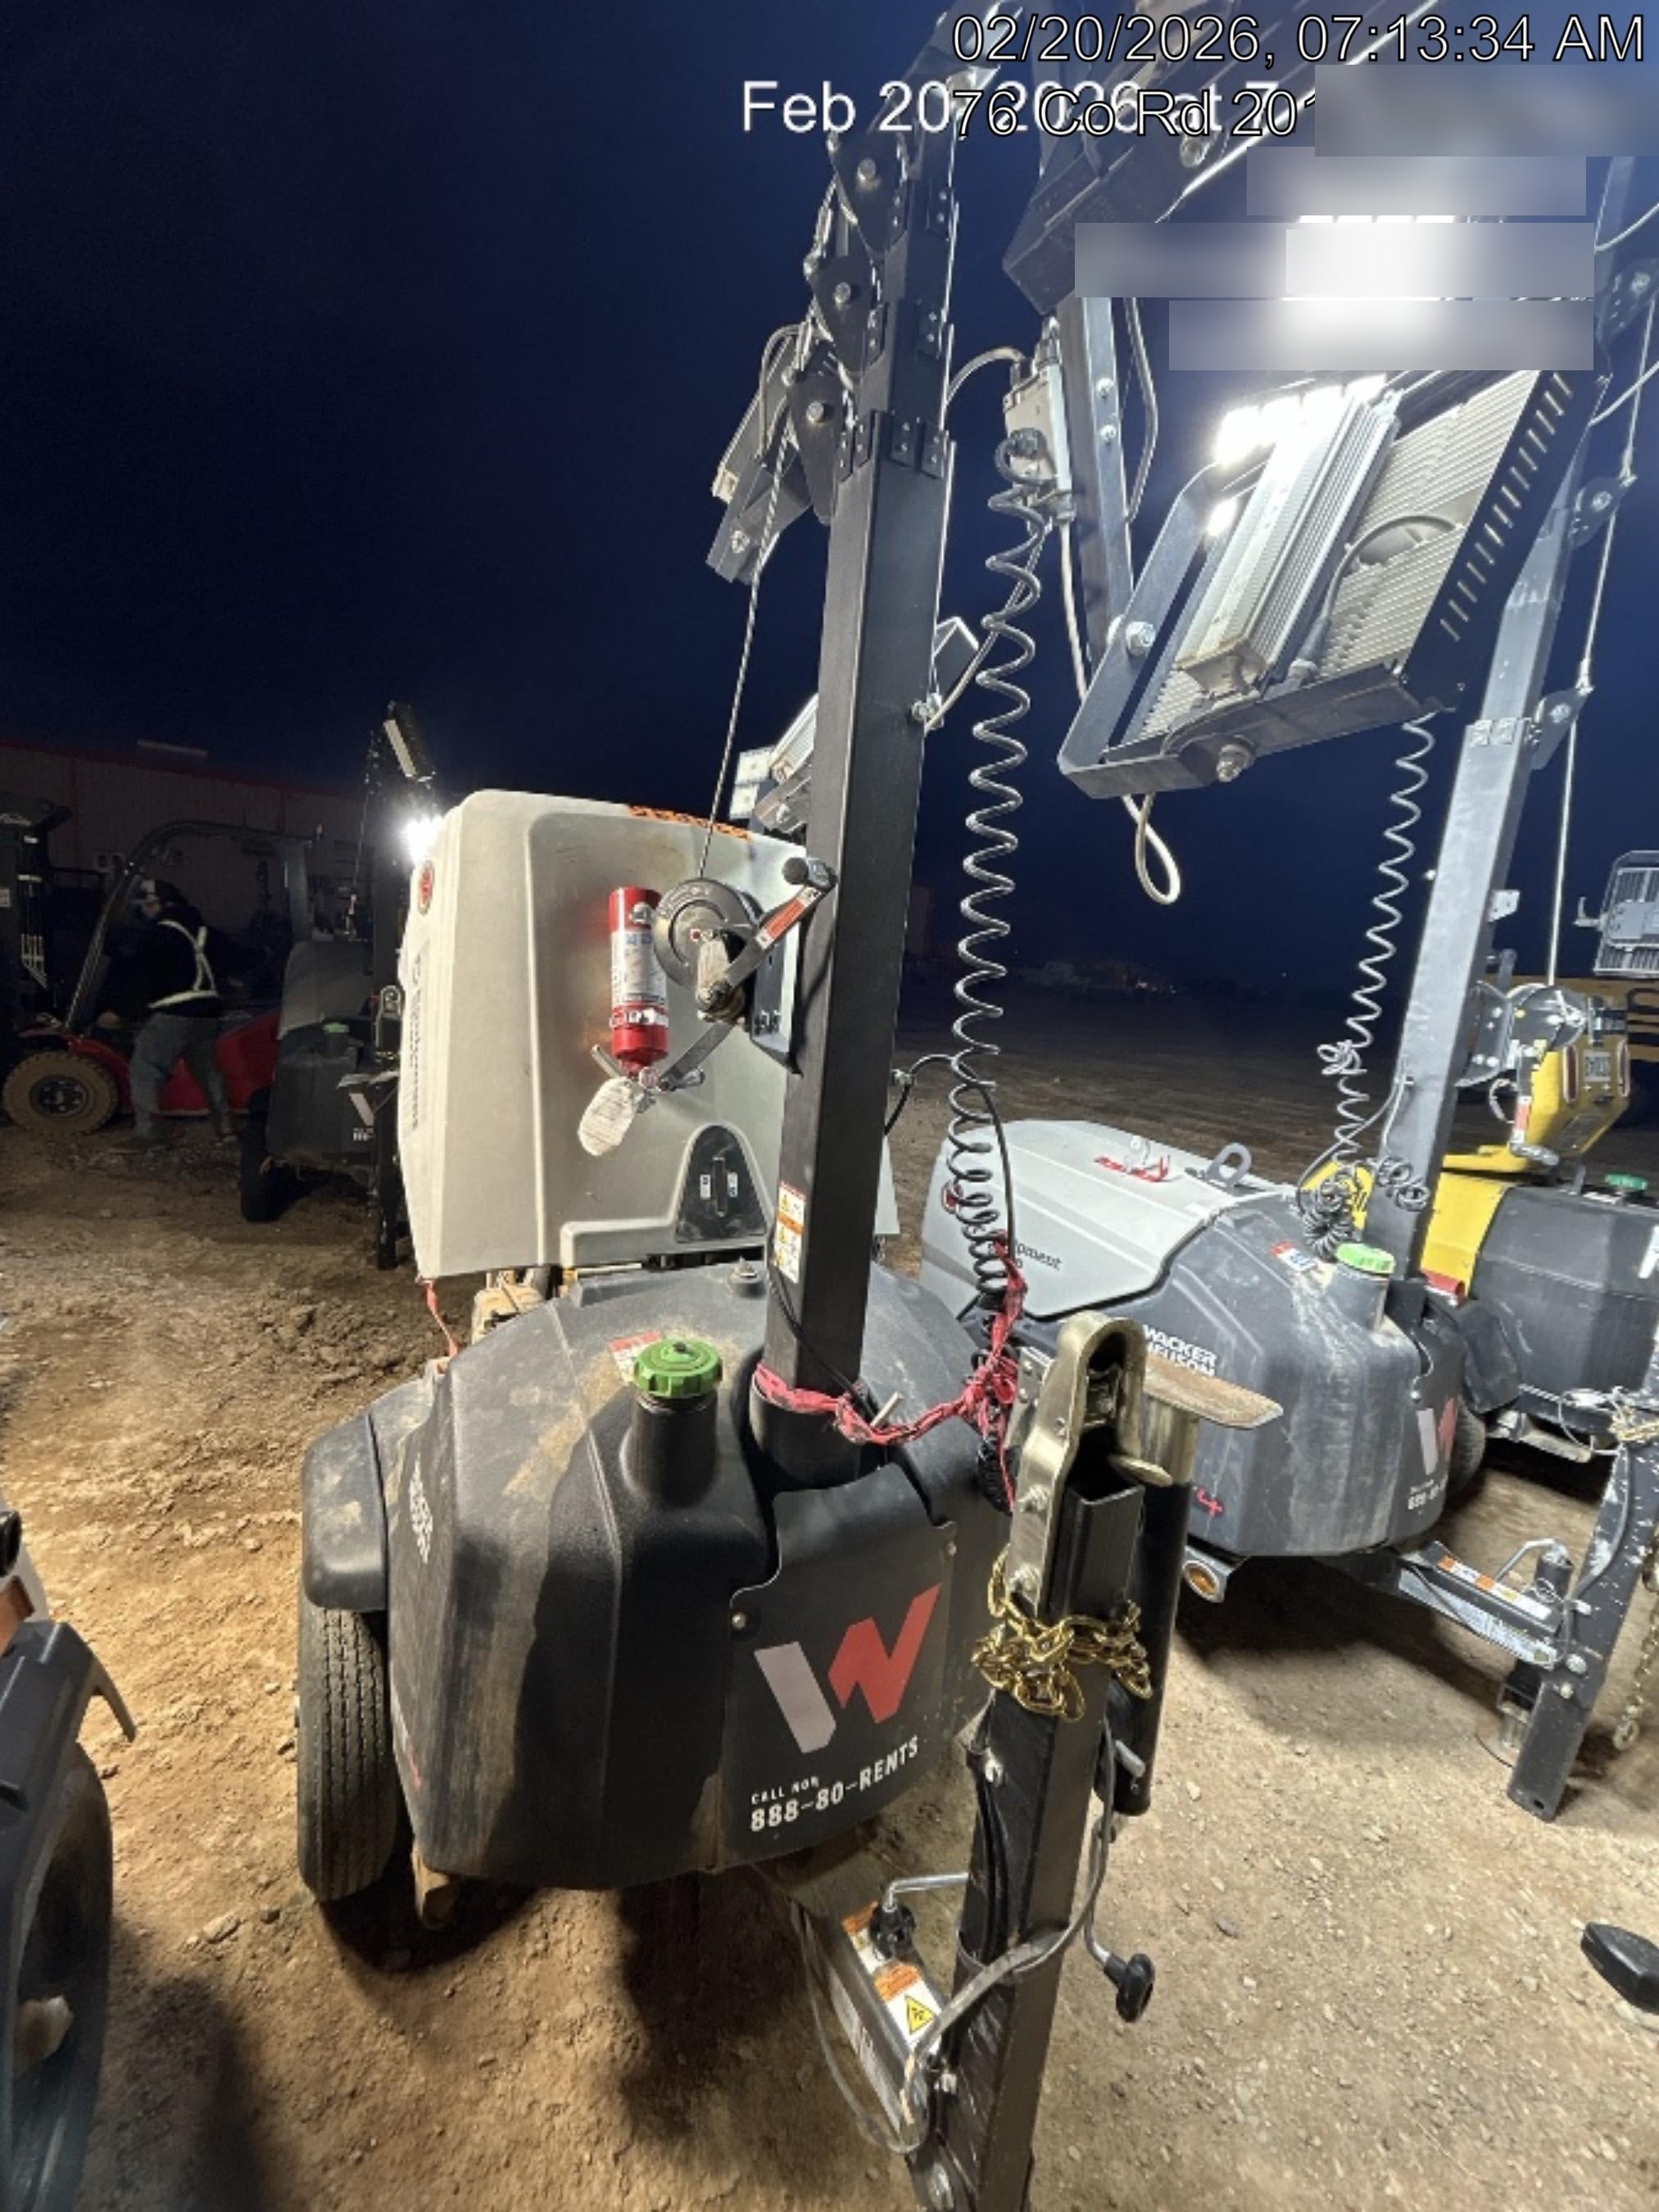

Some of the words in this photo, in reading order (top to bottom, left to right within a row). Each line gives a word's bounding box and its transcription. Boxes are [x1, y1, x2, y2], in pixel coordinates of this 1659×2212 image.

[1143, 1324, 1217, 1370] WACKER
[751, 1734, 918, 1832] 888-80-RENTS
[751, 1786, 785, 1805] CALL
